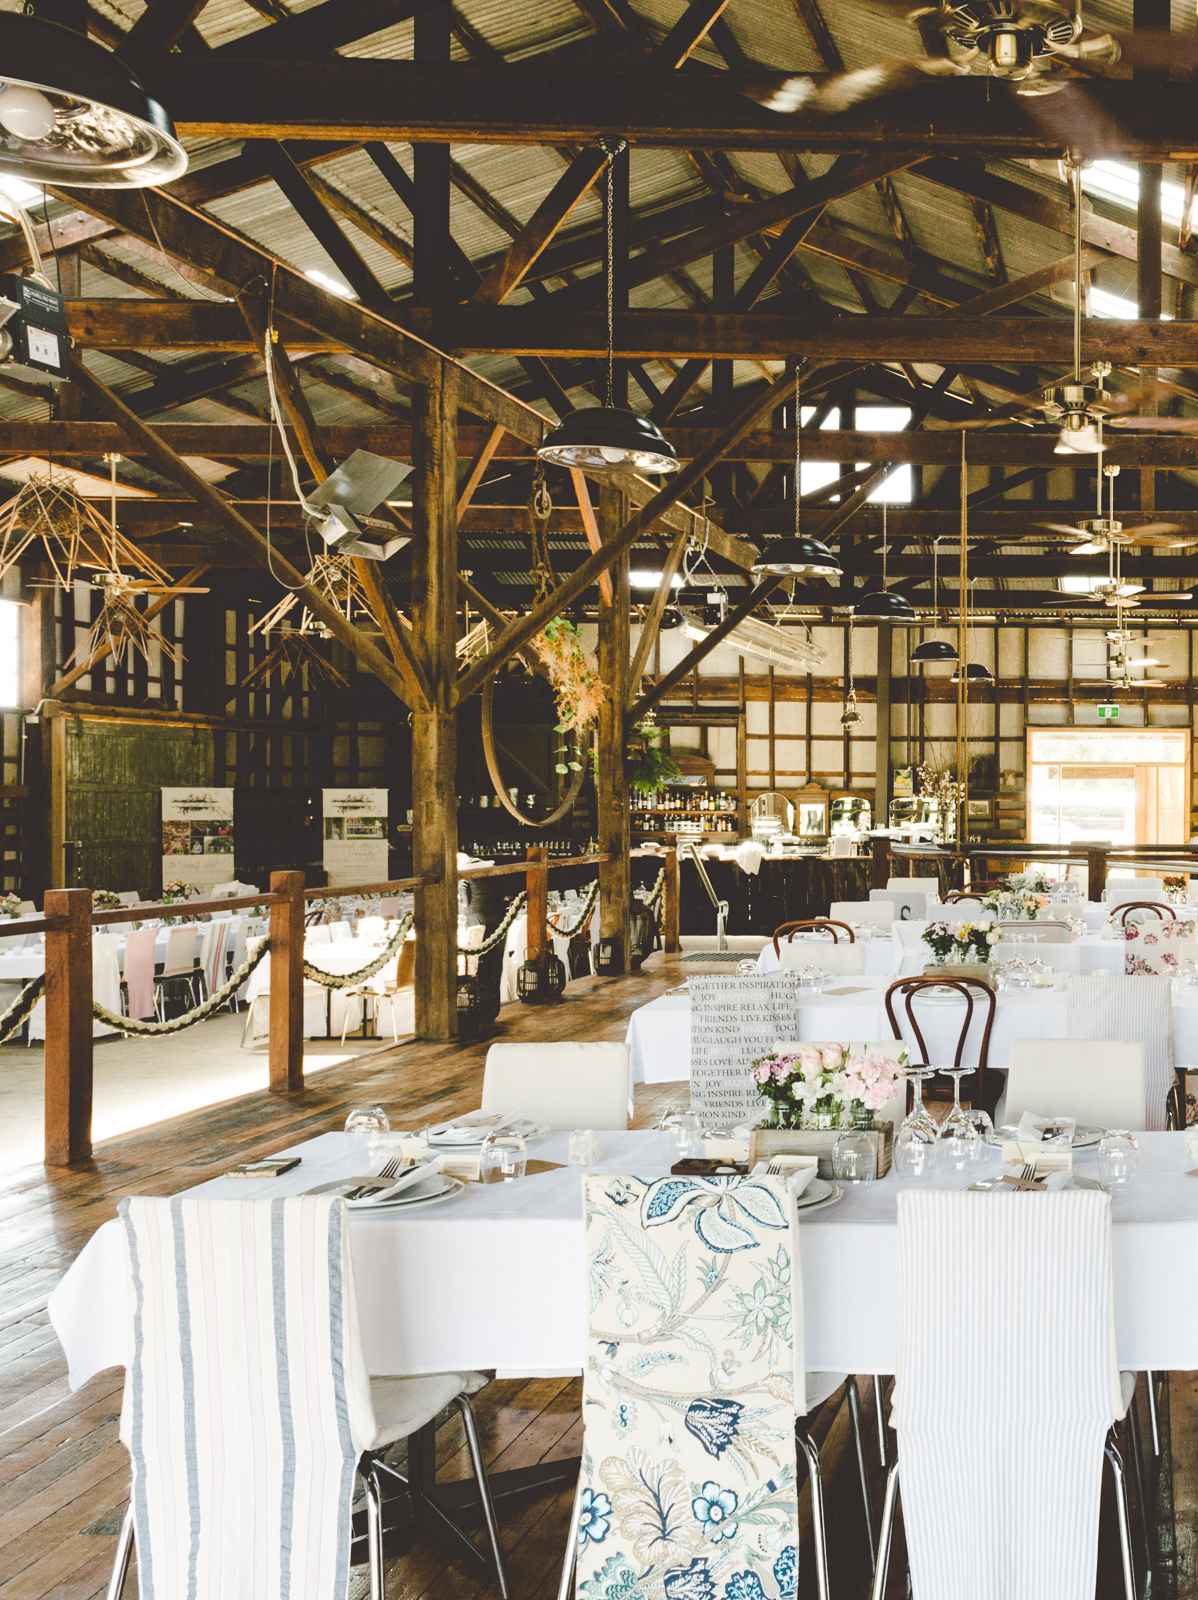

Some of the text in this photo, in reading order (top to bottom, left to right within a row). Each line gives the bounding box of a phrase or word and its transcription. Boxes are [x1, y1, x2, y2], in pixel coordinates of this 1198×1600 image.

[740, 1003, 770, 1012] RELAX
[714, 1025, 740, 1033] KIND
[709, 1058, 734, 1066] LOVE
[691, 1068, 741, 1077] TOGETHER
[704, 1079, 722, 1089] JOY
[707, 1088, 742, 1098] INSPIRE
[703, 1099, 768, 1108] FRIENDS LIVE
[722, 1110, 746, 1119] KIND
